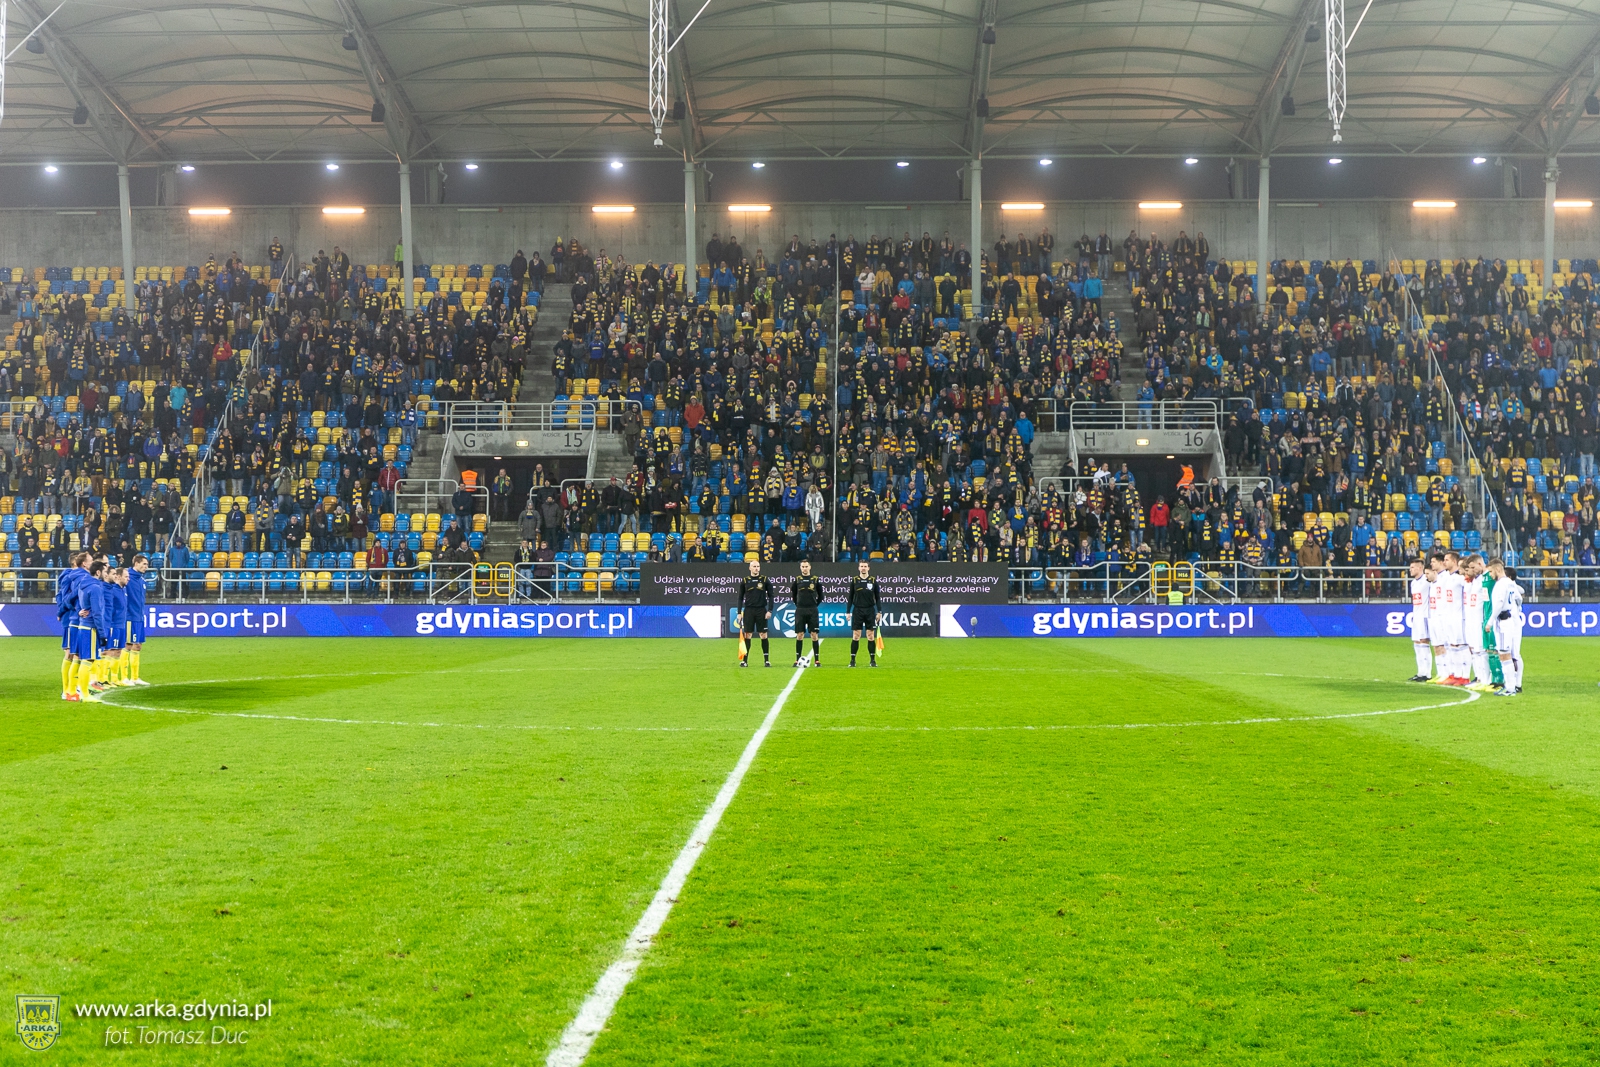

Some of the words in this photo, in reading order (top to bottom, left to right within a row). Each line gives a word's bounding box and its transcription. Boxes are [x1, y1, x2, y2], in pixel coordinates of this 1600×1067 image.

[463, 432, 476, 448] G
[564, 432, 583, 448] 15
[1084, 431, 1096, 447] H
[1184, 431, 1204, 447] 16
[653, 575, 684, 584] Udział
[917, 575, 953, 584] Hazard
[955, 575, 1000, 586] związany
[664, 585, 683, 596] jest
[692, 585, 738, 596] ryzykiem.
[895, 585, 935, 595] posiada
[936, 585, 991, 594] zezwolenie
[415, 607, 634, 635] gdyniasport.pl
[1032, 606, 1254, 635] gdyniasport.pl
